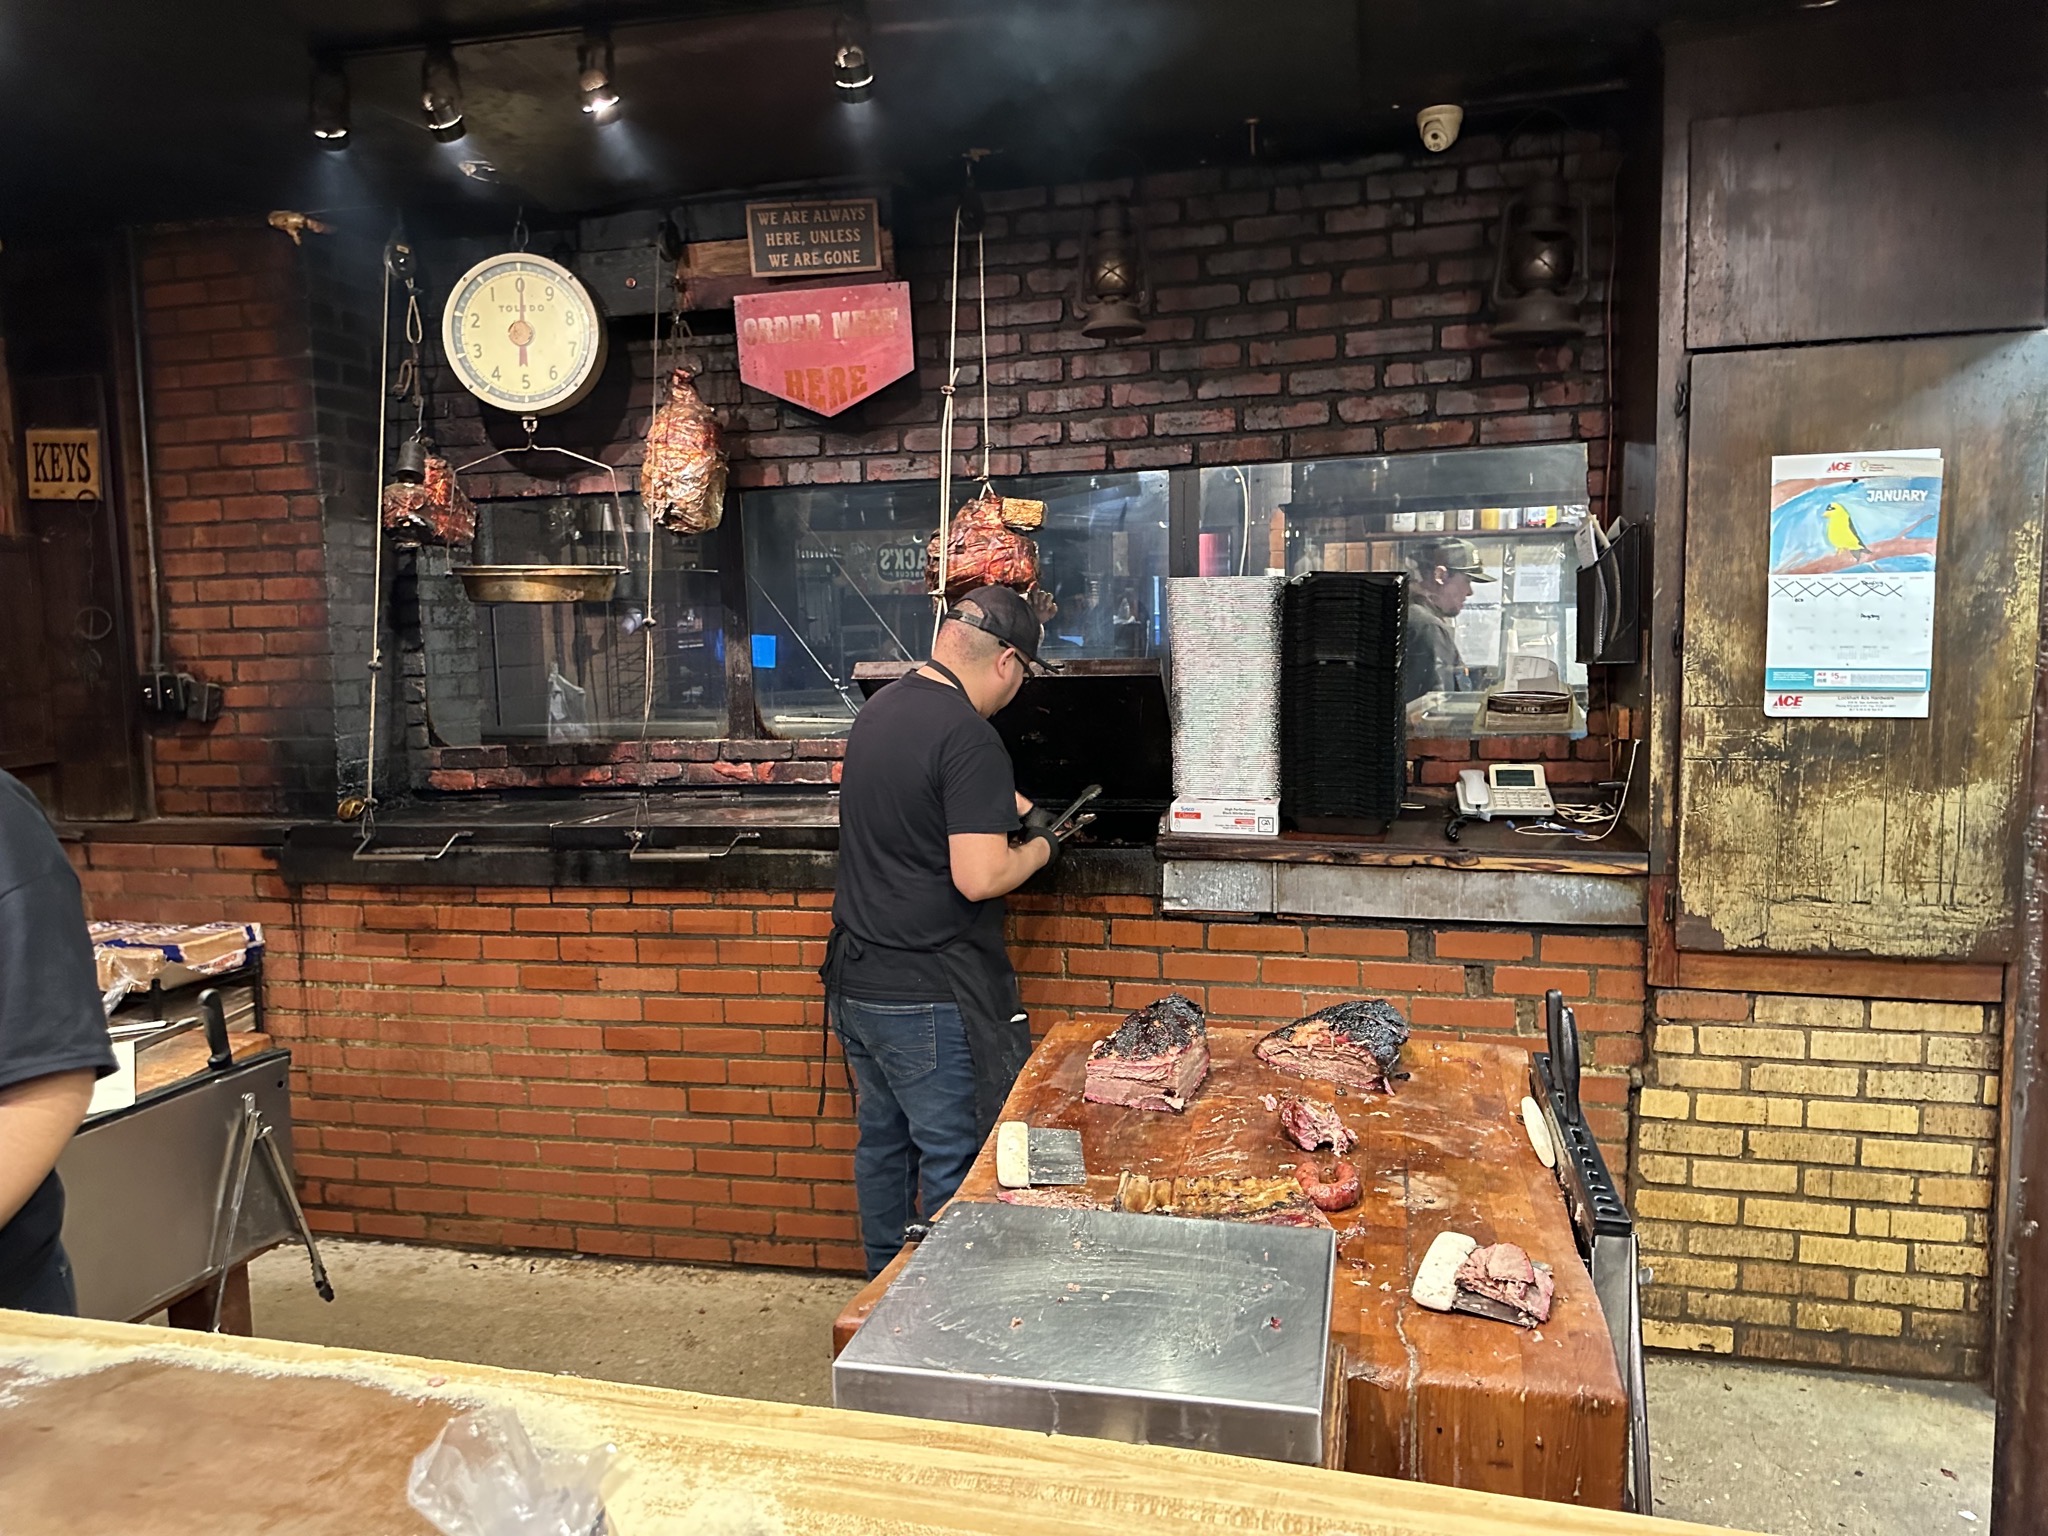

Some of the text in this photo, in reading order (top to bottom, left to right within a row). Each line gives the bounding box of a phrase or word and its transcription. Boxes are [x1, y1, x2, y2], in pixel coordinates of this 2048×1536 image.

[757, 207, 866, 226] WE ARE ALWAYS
[765, 228, 861, 247] HERE, UNLESS
[768, 249, 861, 268] WE ARE GONE
[515, 277, 525, 293] 0
[490, 286, 495, 302] 1
[545, 286, 555, 302] 9
[470, 313, 480, 329] 2
[565, 310, 575, 326] 8
[743, 313, 821, 346] ORDER
[473, 343, 482, 359] 3
[568, 341, 577, 358] 7
[491, 365, 501, 381] 4
[549, 365, 559, 381] 6
[522, 374, 531, 389] 5
[784, 364, 868, 411] HERE
[32, 442, 91, 484] KEYS
[1827, 462, 1852, 473] ACE
[1866, 489, 1929, 503] JANUARY
[1773, 694, 1804, 707] ACE
